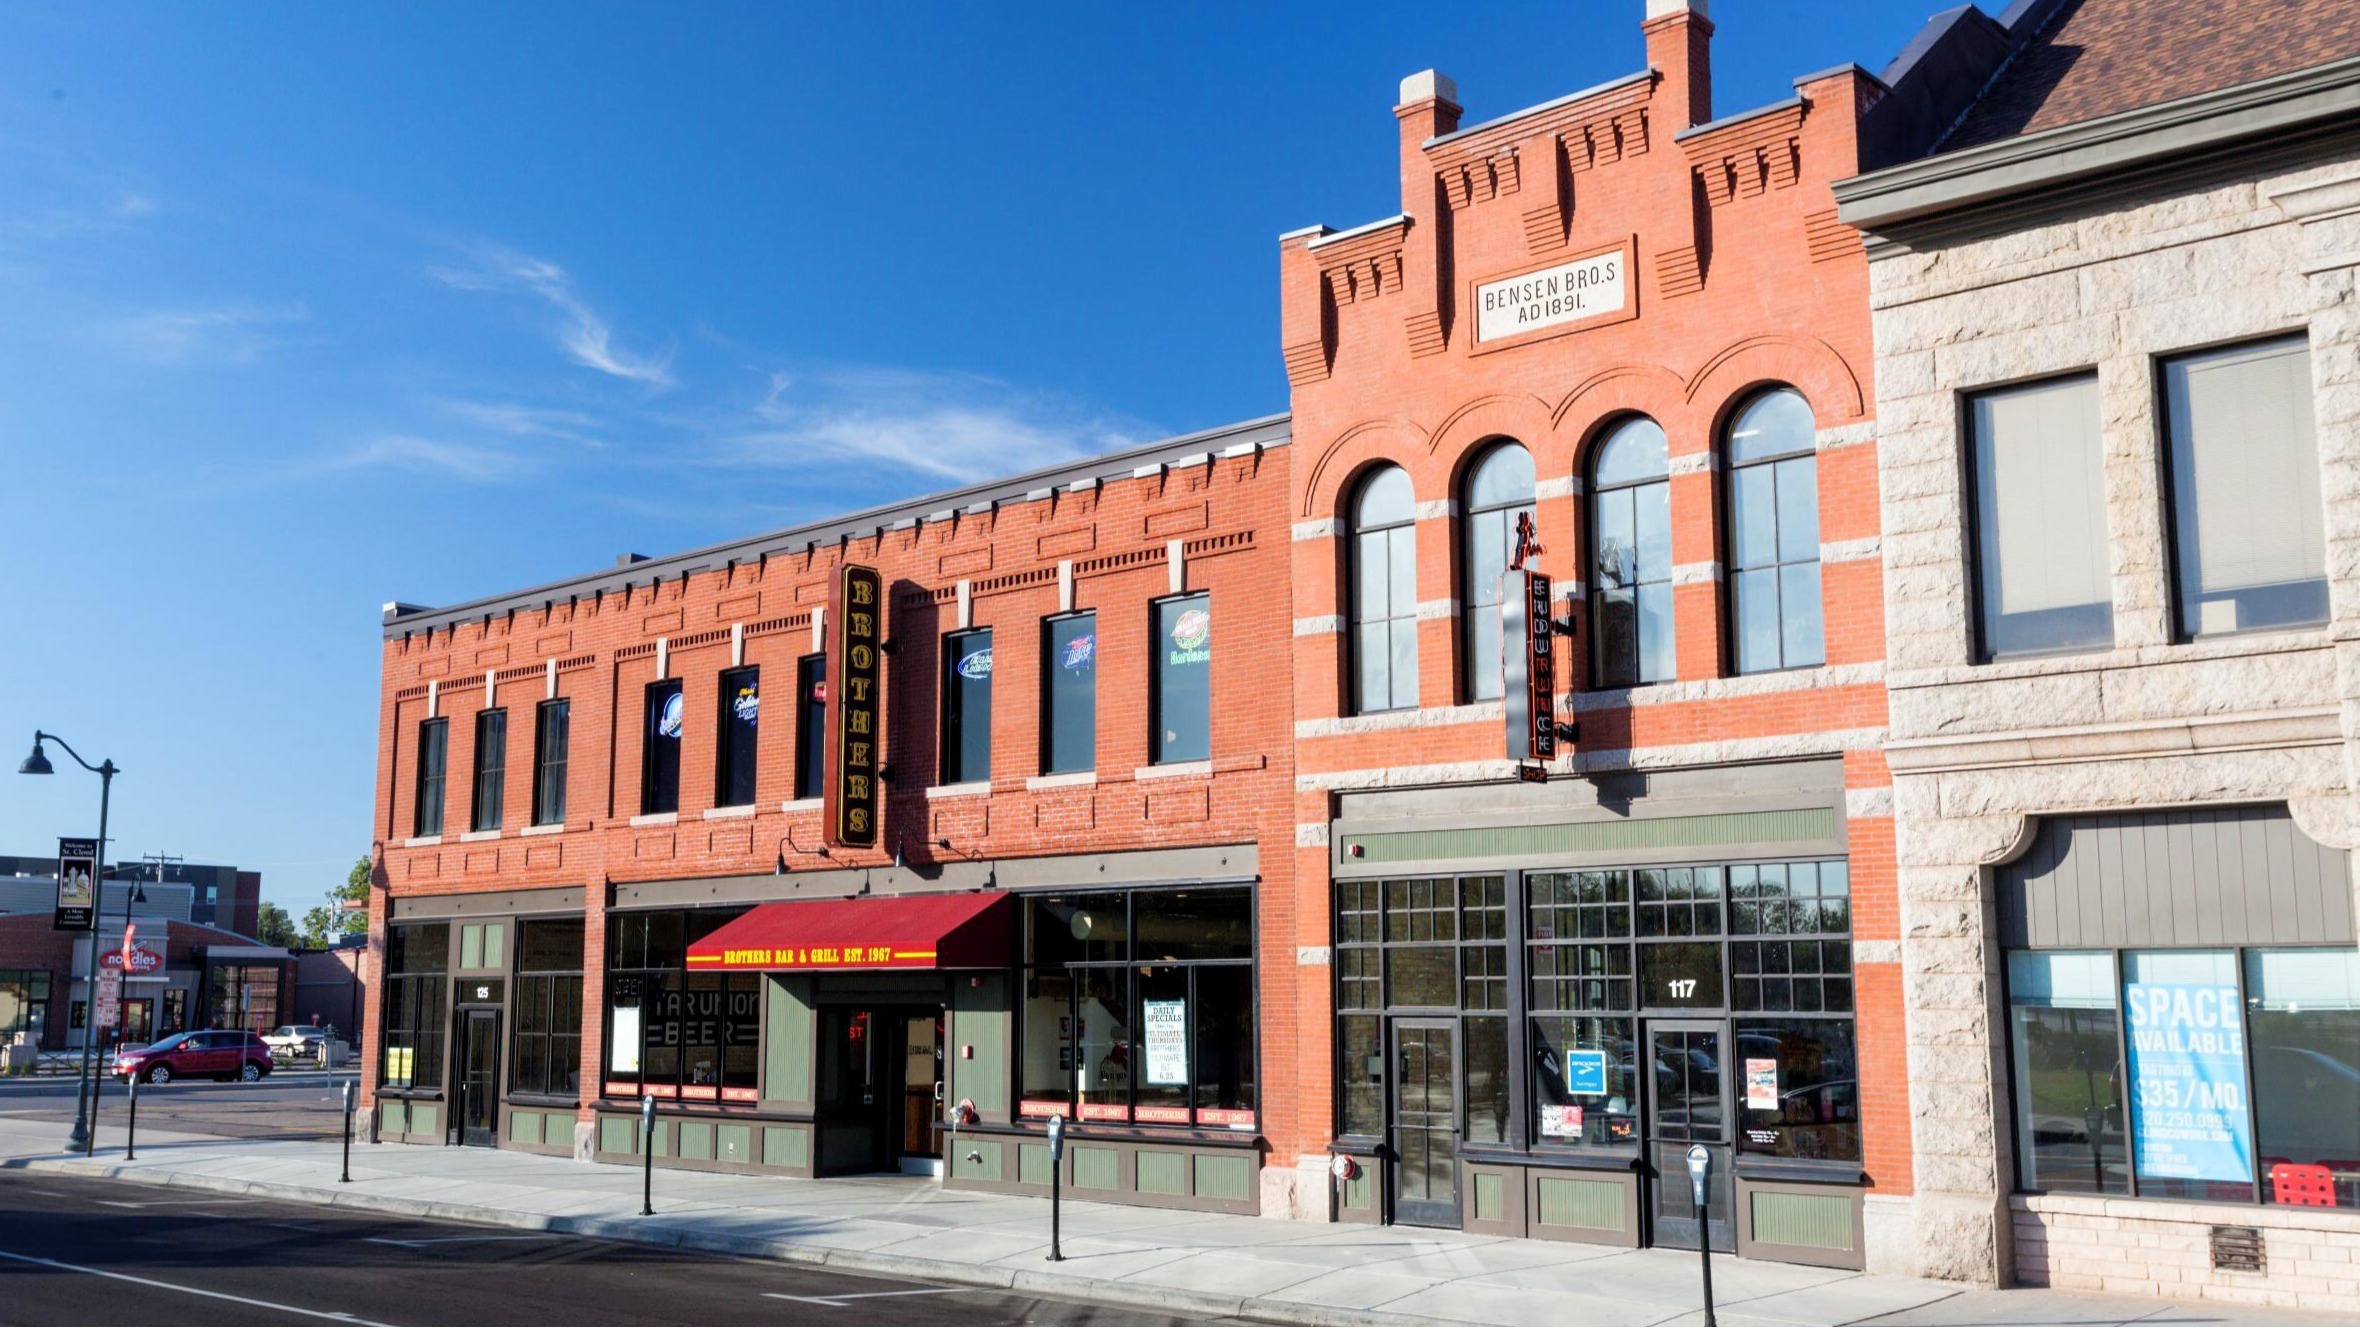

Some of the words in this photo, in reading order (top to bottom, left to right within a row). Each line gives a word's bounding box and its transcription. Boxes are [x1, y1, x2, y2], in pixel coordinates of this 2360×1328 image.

[1486, 276, 1558, 311] BENSEN
[1565, 262, 1615, 292] BRO.S
[848, 580, 873, 833] BROTHERS
[1523, 768, 1545, 780] SHOP
[73, 848, 94, 856] Cloud
[108, 951, 156, 965] nodles
[724, 950, 771, 964] BROTHERS
[775, 949, 793, 963] BAR
[799, 949, 807, 963] &
[811, 948, 839, 962] GRILL
[844, 948, 866, 962] EST.
[868, 948, 891, 961] 1967
[1668, 979, 1697, 998] 117
[1153, 1007, 1175, 1015] DAILY
[2126, 987, 2241, 1029] SPACE
[1147, 1014, 1182, 1022] SPECIALS
[665, 1021, 734, 1045] BEER
[2129, 1030, 2243, 1055] AVAILABLE
[1023, 1104, 1067, 1115] BROTHERS
[1083, 1107, 1101, 1116] EST.
[1103, 1108, 1122, 1117] 1967
[1138, 1109, 1187, 1120] BROTHERS
[1203, 1111, 1225, 1122] EST.
[1226, 1112, 1247, 1123] 1967
